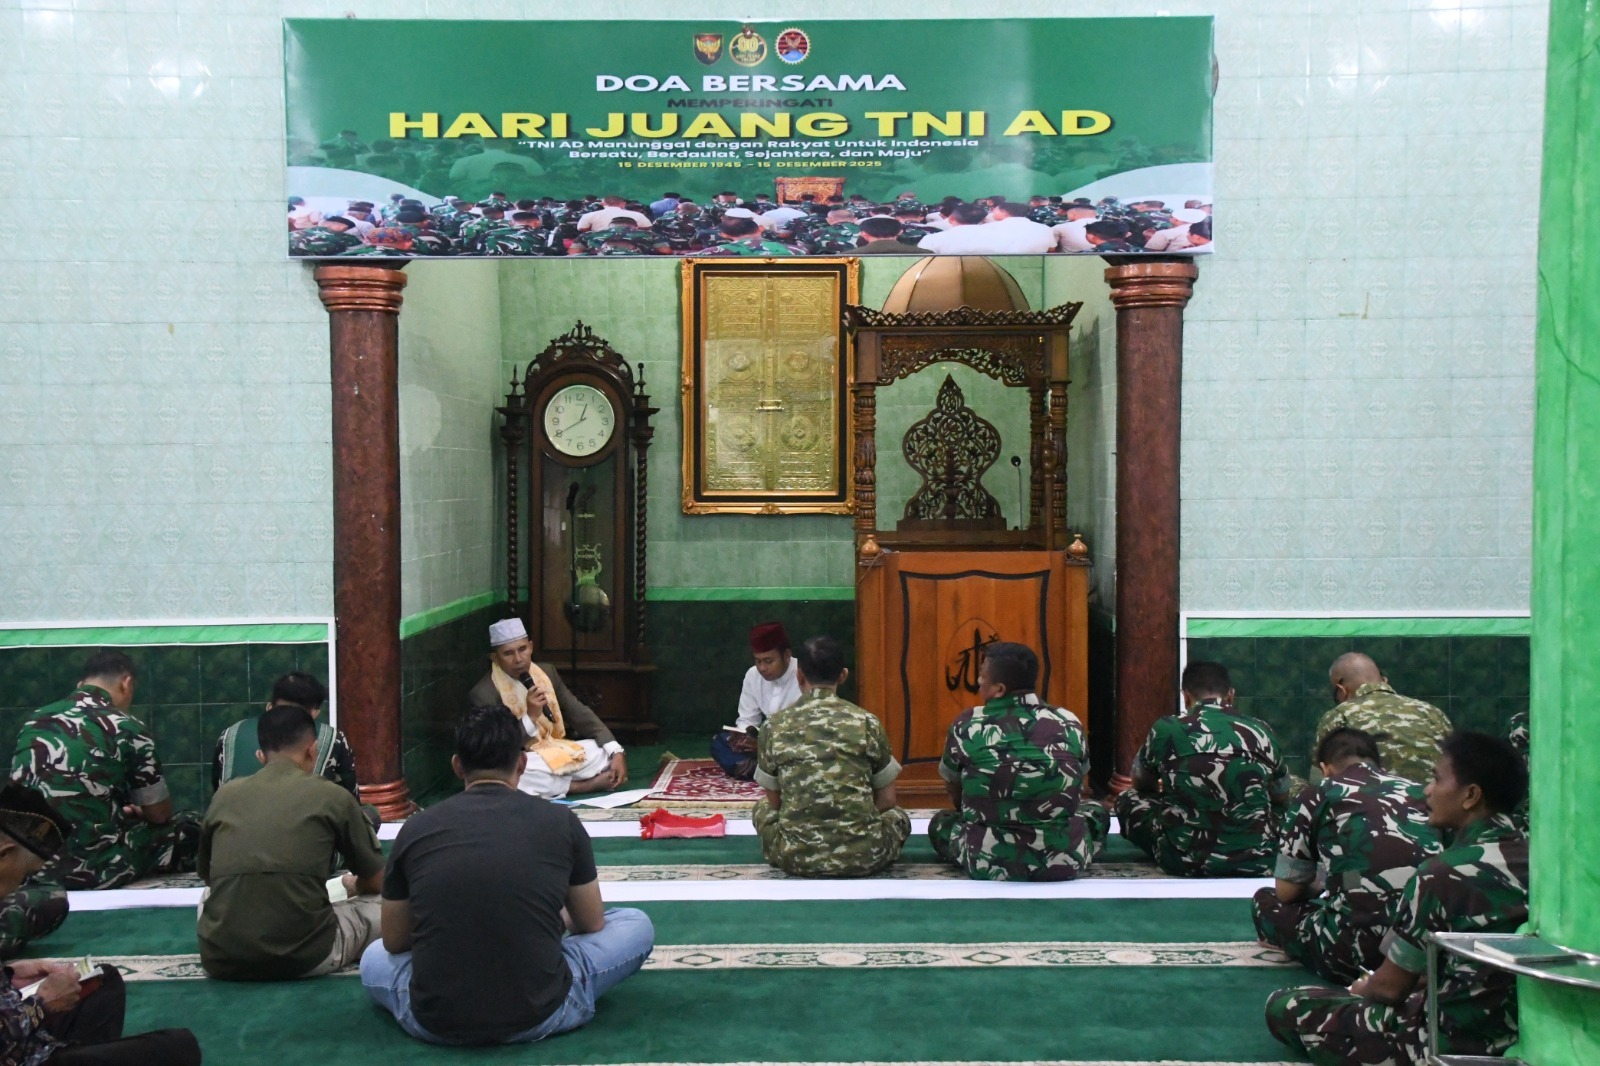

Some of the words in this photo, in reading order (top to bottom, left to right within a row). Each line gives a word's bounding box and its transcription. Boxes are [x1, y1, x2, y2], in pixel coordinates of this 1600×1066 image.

[596, 75, 691, 92] DOA
[702, 74, 907, 92] BERSAMA
[667, 98, 833, 108] MEMPERINGATI
[389, 112, 567, 139] HARI
[585, 112, 849, 138] JUANG
[864, 111, 985, 137] TNI
[1002, 110, 1112, 136] AD
[559, 141, 584, 149] AD
[588, 141, 690, 151] Manunggal
[694, 141, 763, 151] dengan
[767, 140, 830, 150] Rakyat
[834, 140, 887, 148] Untuk
[891, 139, 979, 147] Indonesia
[569, 151, 643, 159] Bersatu,
[647, 151, 740, 159] Berdaulat,
[744, 150, 835, 160] Sejahtera,
[839, 150, 874, 158] dan
[598, 404, 605, 413] 2
[598, 430, 604, 438] 4
[566, 438, 572, 447] 7
[576, 442, 584, 450] 6
